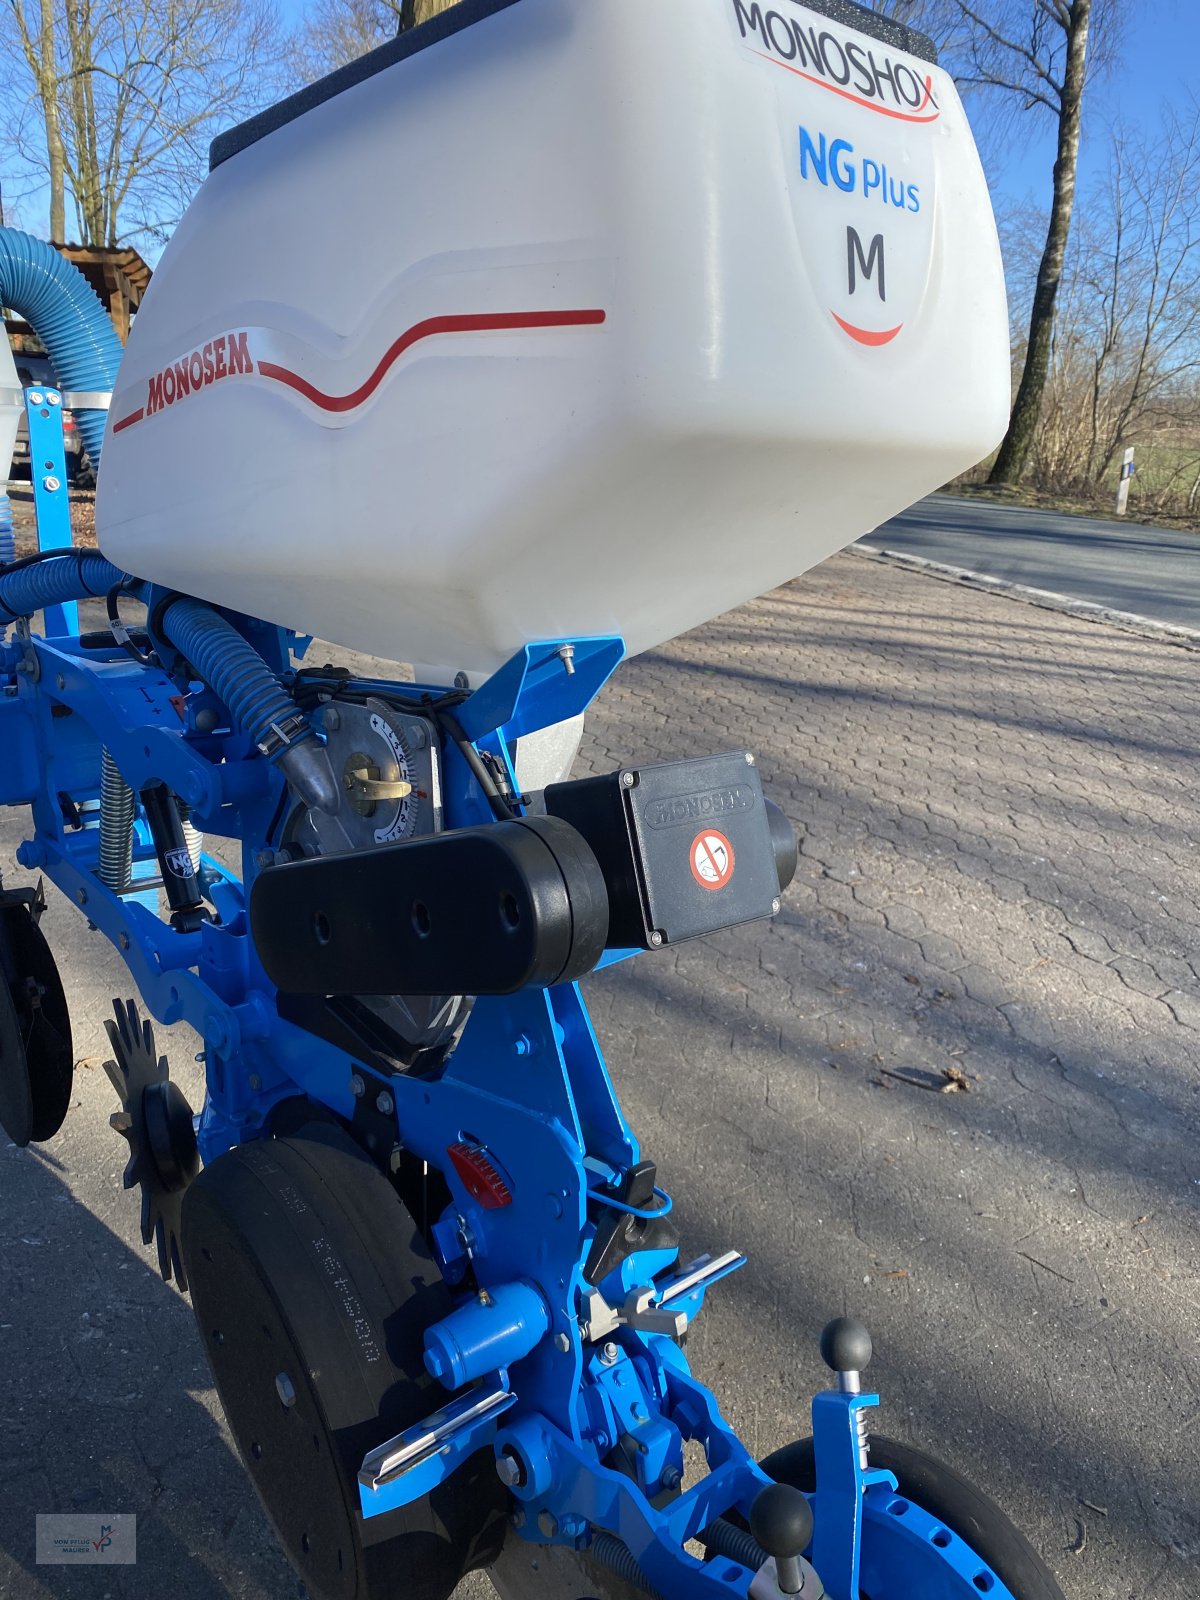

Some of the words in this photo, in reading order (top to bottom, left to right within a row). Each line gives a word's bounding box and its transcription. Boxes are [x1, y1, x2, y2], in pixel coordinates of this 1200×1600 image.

[733, 0, 939, 111] MONOSHOX
[799, 125, 855, 193] NG
[863, 158, 920, 213] Plus
[847, 225, 885, 302] M
[147, 332, 253, 416] MONOSEM
